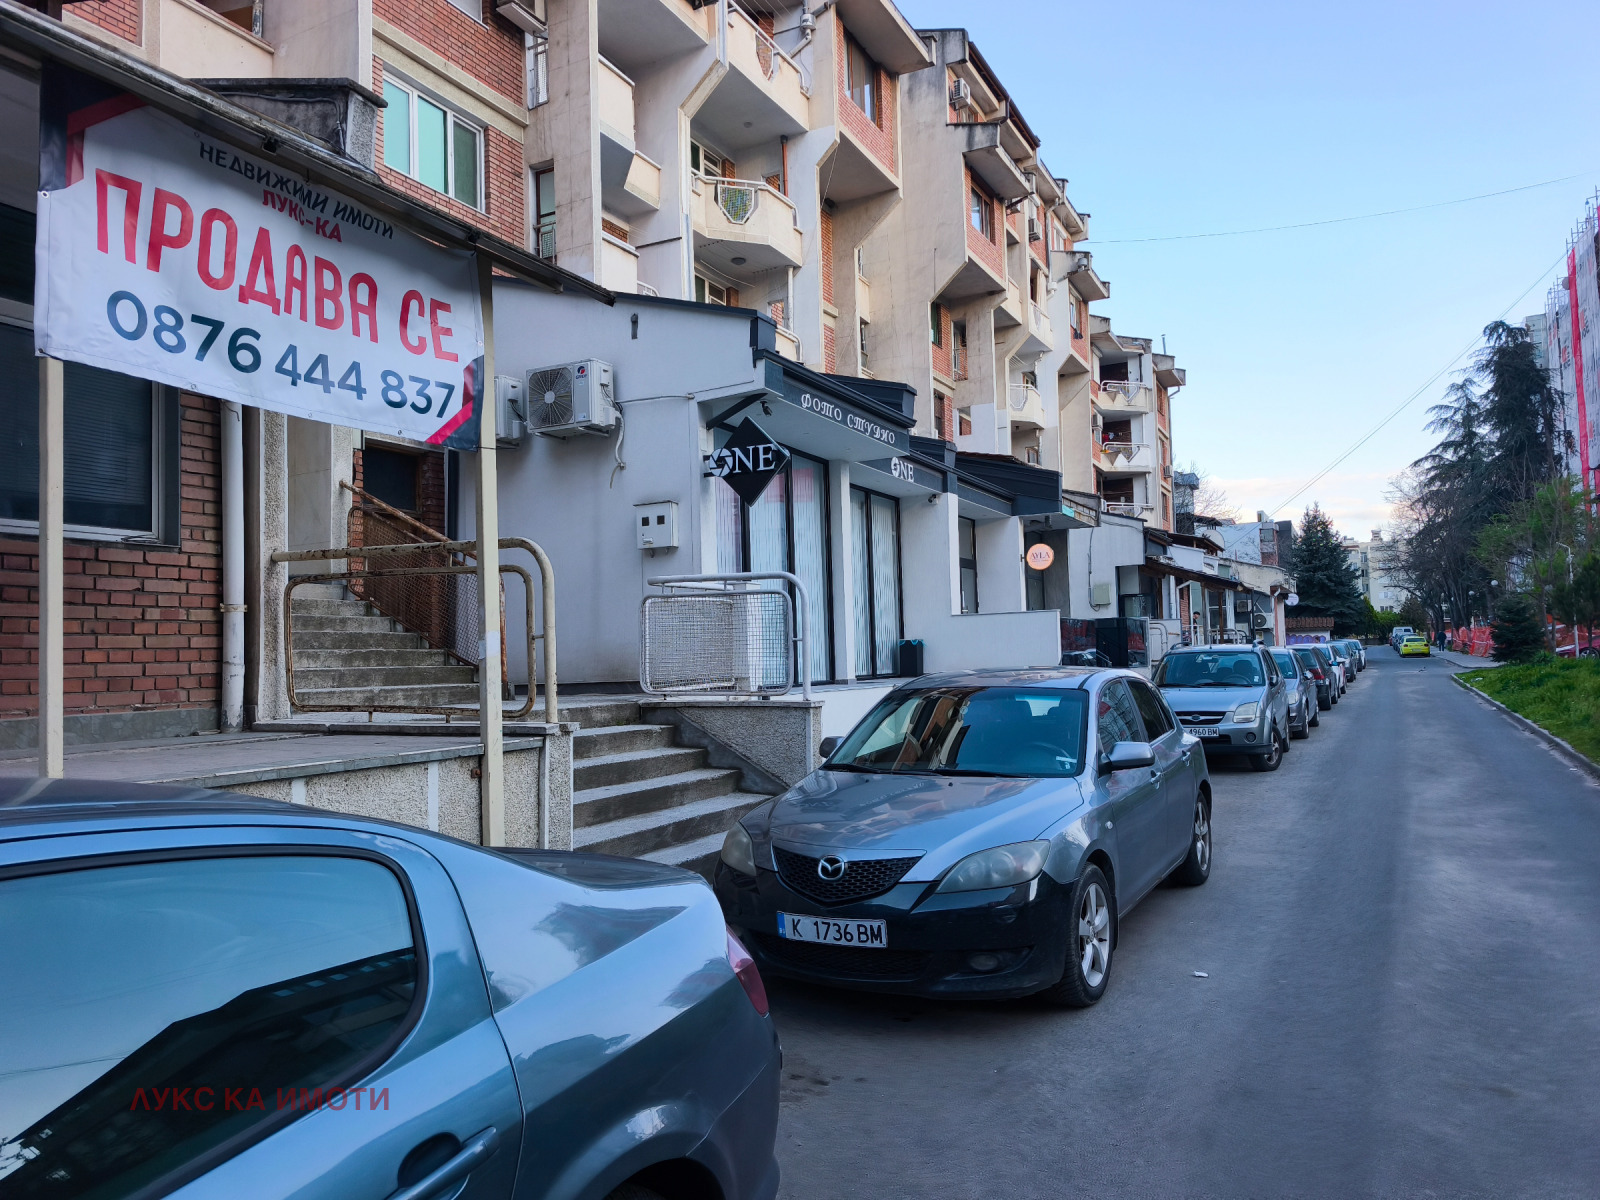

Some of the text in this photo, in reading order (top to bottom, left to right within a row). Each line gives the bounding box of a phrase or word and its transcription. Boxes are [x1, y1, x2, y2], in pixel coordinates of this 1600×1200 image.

[199, 141, 394, 240] НЕДВИЖИМИ ИМОТИ
[262, 189, 342, 243] ЛУКС-КА
[95, 168, 459, 363] ПРОДАВА СЕ
[106, 290, 456, 419] 0876 444 837
[791, 917, 883, 944] K 1736 BM
